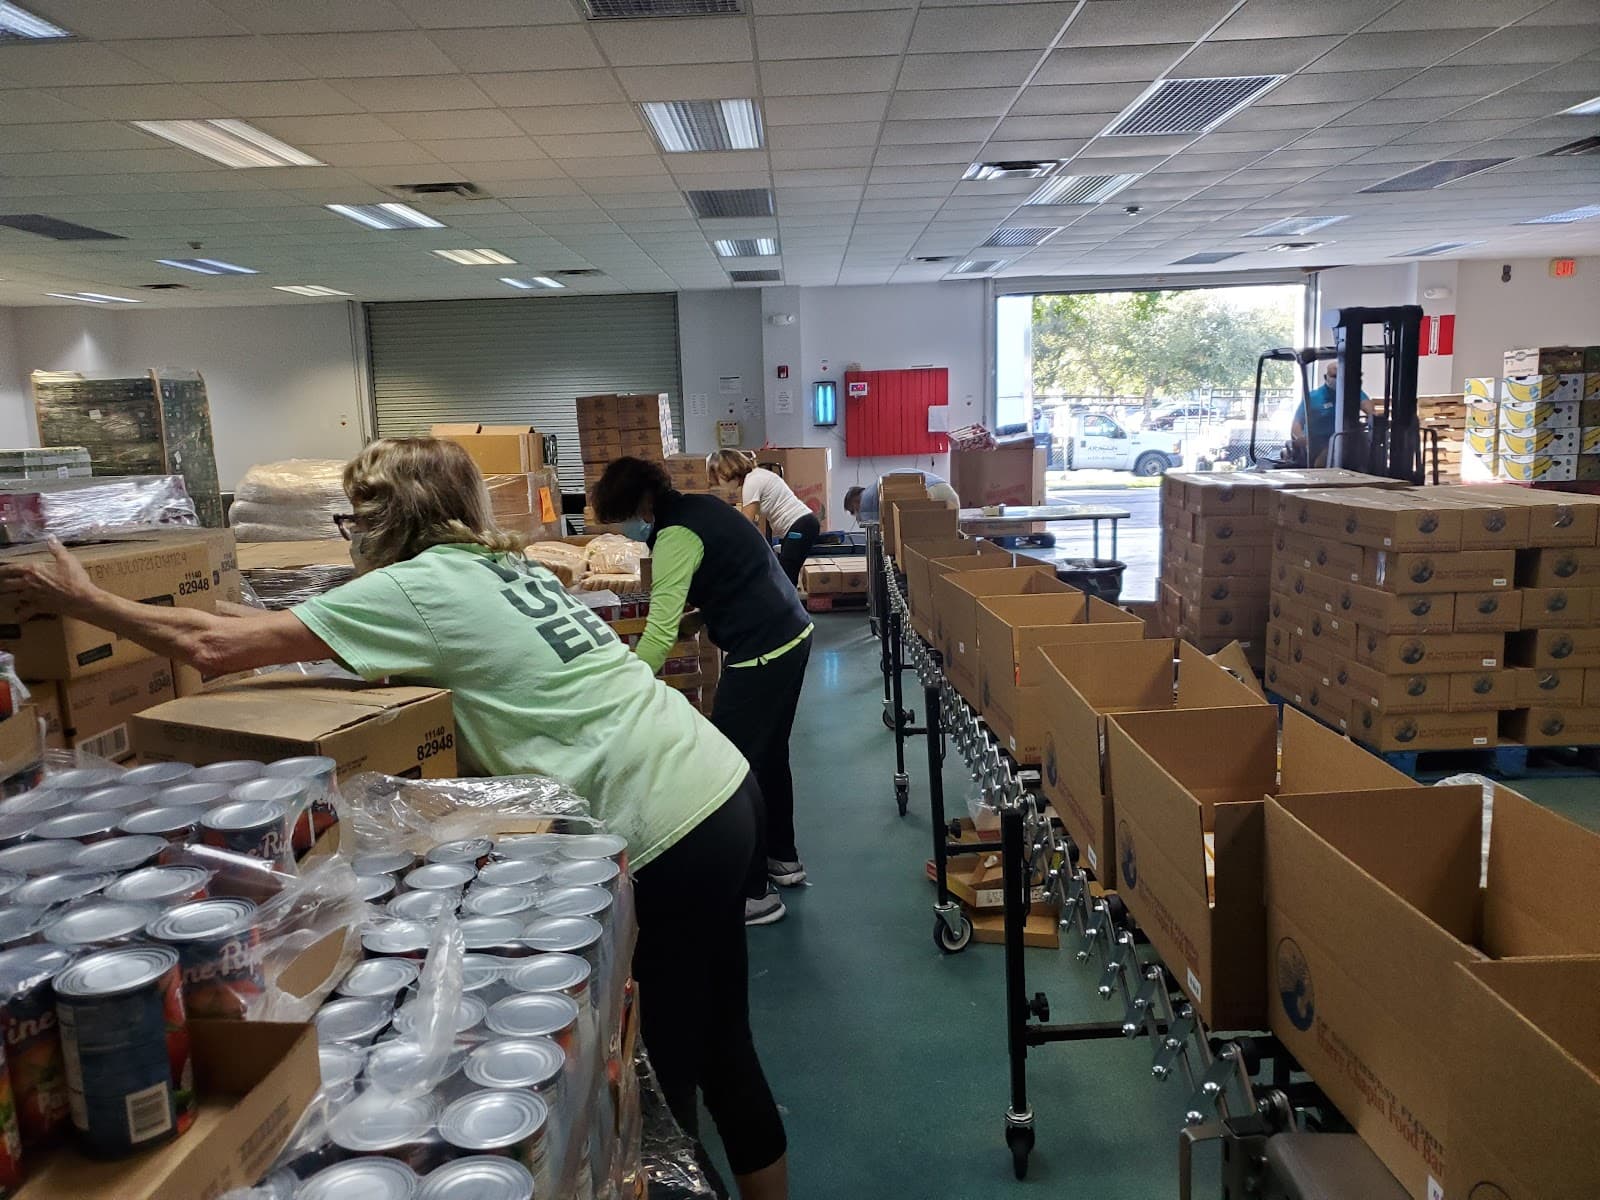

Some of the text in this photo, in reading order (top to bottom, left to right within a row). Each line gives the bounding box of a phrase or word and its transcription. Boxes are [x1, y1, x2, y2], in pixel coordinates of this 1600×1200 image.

[178, 578, 210, 596] 82948
[535, 609, 617, 665] EE
[416, 733, 453, 761] 82948
[424, 726, 446, 741] 11140
[7, 1010, 56, 1045] ine
